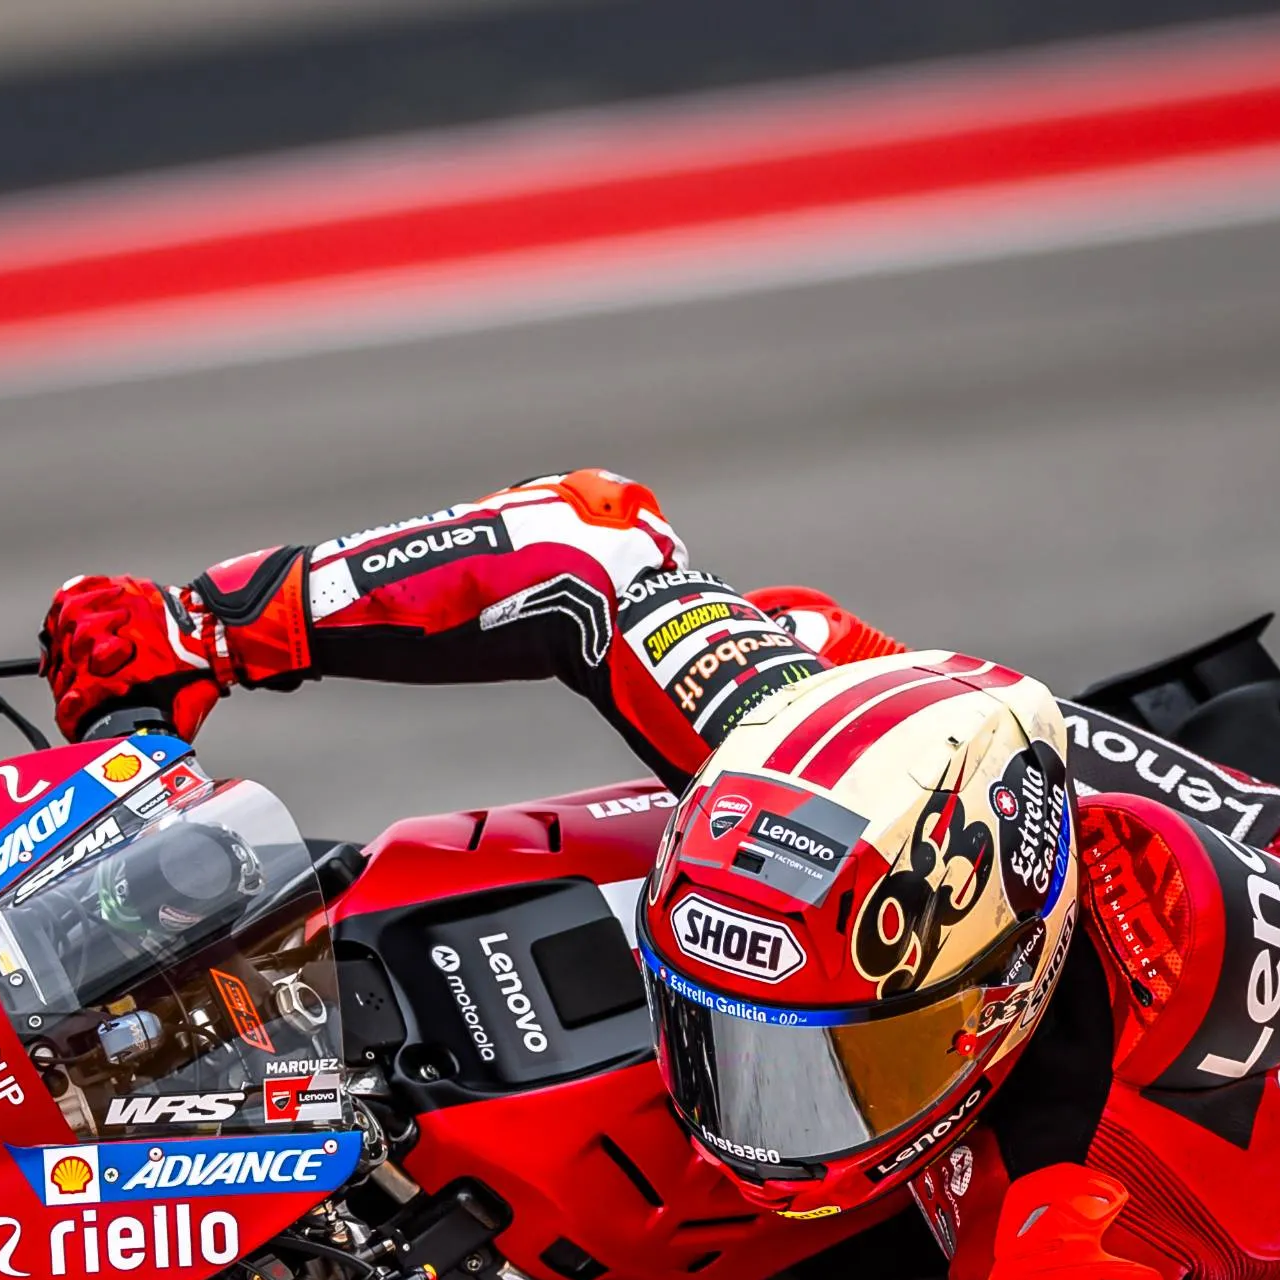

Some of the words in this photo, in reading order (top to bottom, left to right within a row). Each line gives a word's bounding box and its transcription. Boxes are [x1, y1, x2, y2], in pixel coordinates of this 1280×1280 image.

[362, 516, 498, 574] Lenovo
[673, 632, 794, 712] aruba.it
[586, 791, 679, 820] CATI
[1063, 713, 1265, 844] Lenov
[757, 817, 835, 862] Lenovo
[1011, 765, 1045, 886] Estrella
[13, 814, 127, 905] WRS
[773, 853, 804, 872] FACTORY
[803, 866, 825, 881] TEAM
[683, 908, 784, 973] SHOEI
[1001, 926, 1045, 987] VERTICAL
[447, 974, 496, 1062] motorola
[477, 931, 549, 1054] Lenovo
[669, 974, 714, 1008] Estrella
[715, 997, 767, 1023] Galicia
[266, 1058, 339, 1074] MARQUEZ
[104, 1092, 247, 1125] WRS
[298, 1091, 336, 1103] Lenovo
[700, 1124, 782, 1164] Insta360
[876, 1088, 982, 1175] Lenovo
[121, 1147, 326, 1192] ADVANCE
[48, 1202, 241, 1277] riello
